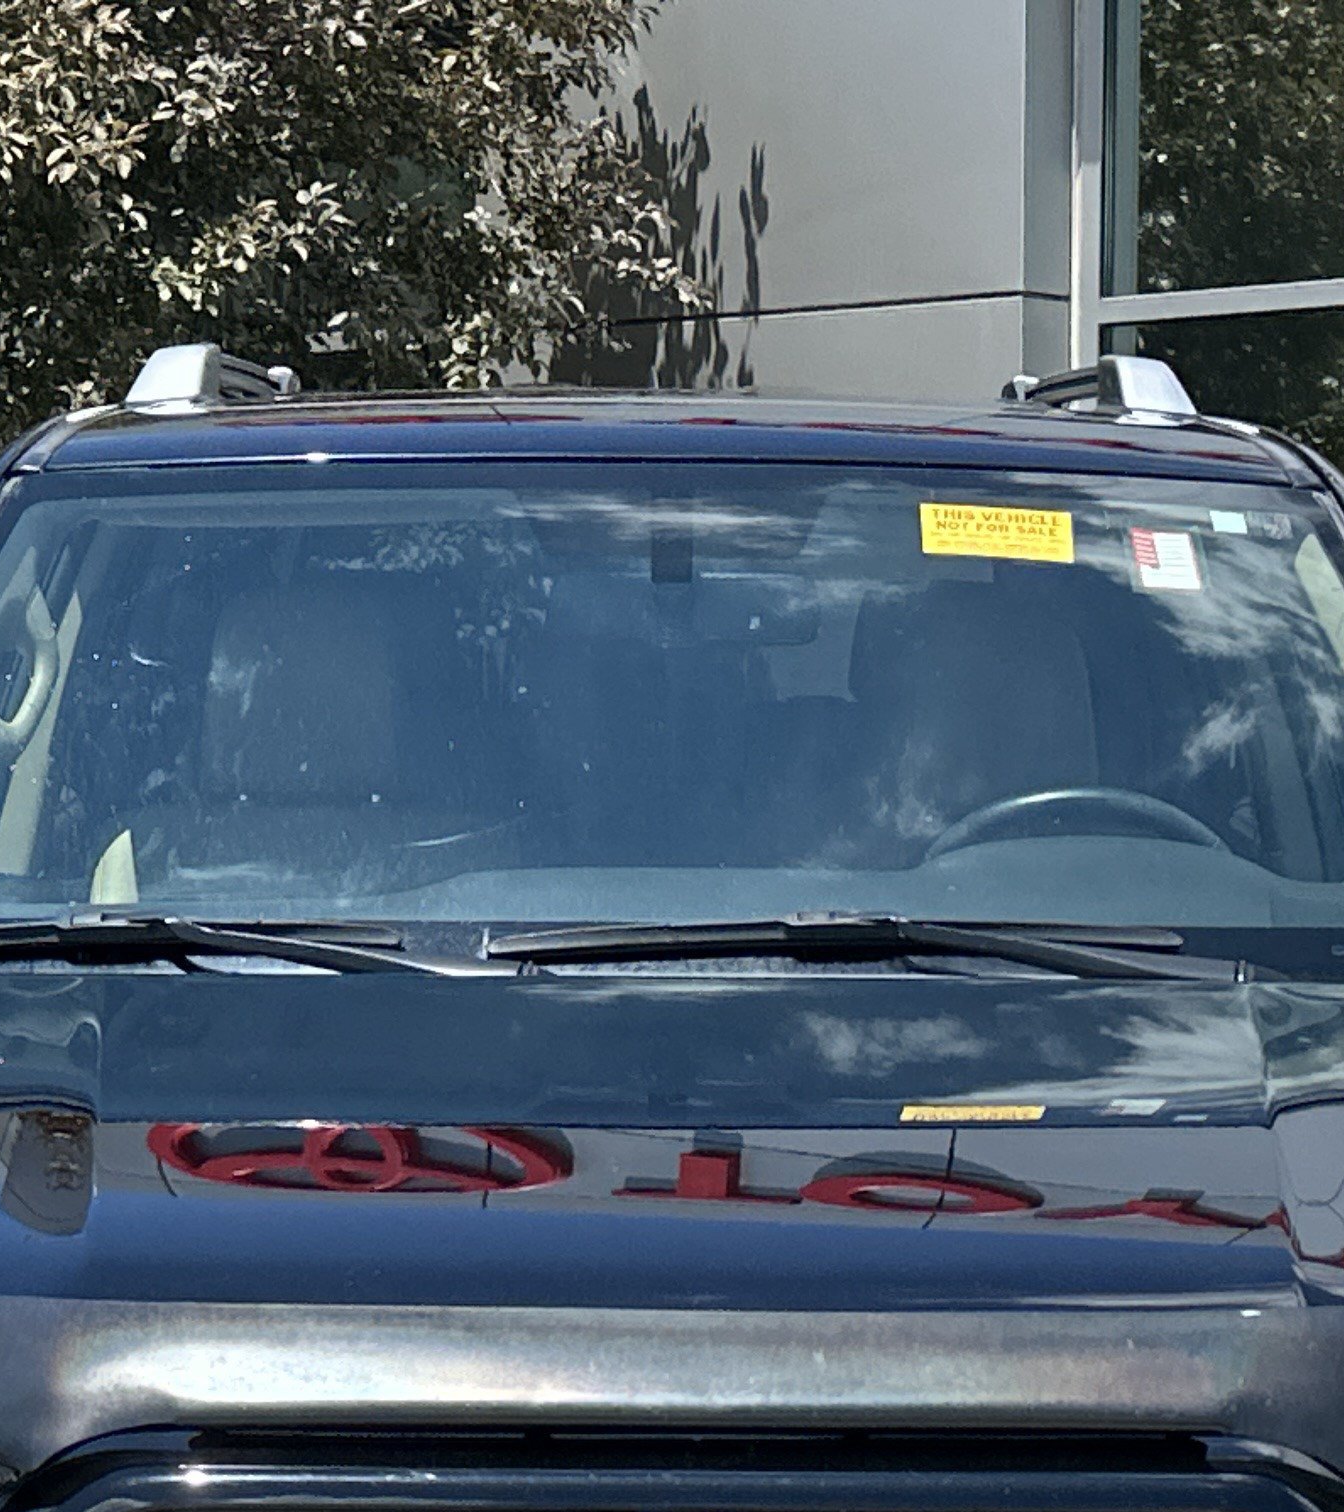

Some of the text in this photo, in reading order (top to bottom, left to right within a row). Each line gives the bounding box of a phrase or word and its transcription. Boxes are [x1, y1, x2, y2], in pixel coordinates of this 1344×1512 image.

[932, 508, 1062, 527] THIS VEHICLE
[936, 520, 1058, 537] NOT FOR SALE
